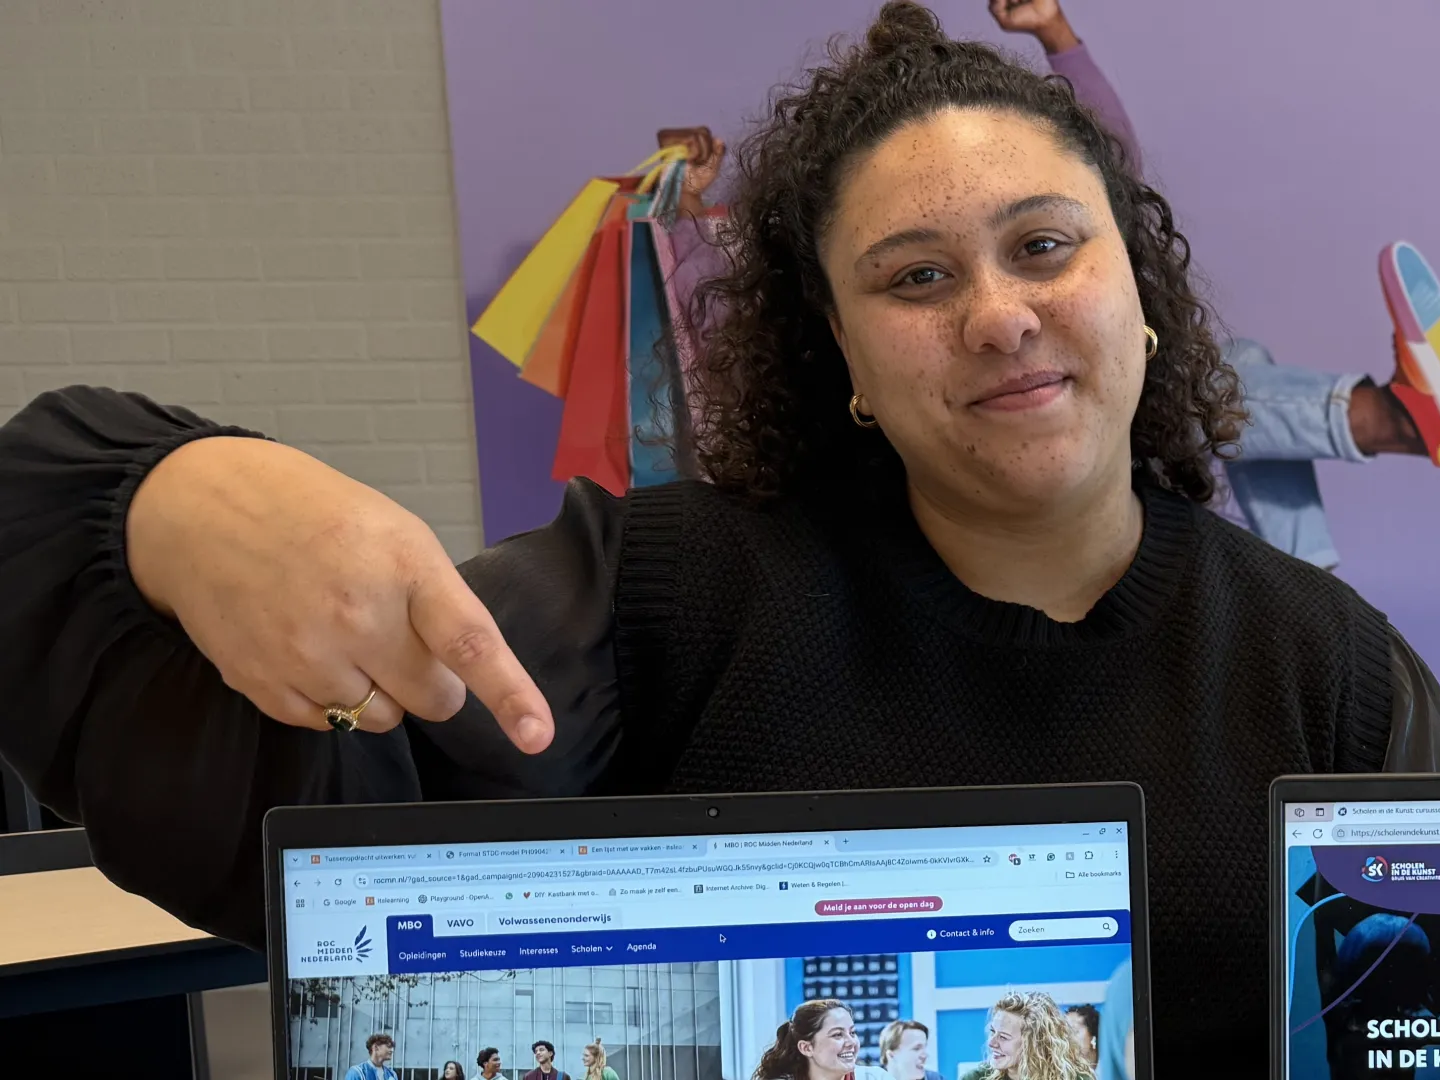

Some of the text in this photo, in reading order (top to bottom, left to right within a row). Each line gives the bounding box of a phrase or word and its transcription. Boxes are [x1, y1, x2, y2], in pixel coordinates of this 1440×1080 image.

[1352, 807, 1377, 815] Scholen
[1391, 862, 1425, 870] SCHOLEN
[791, 881, 811, 889] Weten
[817, 881, 841, 889] Regelen
[431, 894, 465, 902] Playground
[335, 899, 357, 907] Google
[823, 904, 843, 912] Meld
[844, 903, 852, 913] je
[887, 901, 898, 909] de
[899, 902, 918, 910] open
[920, 900, 935, 909] dag
[447, 918, 474, 928] VAVO
[498, 913, 612, 926] Volwassenenonderwijs
[397, 920, 423, 930] MBO
[1018, 925, 1045, 934] Zoeken
[939, 927, 995, 938] Contact & info
[317, 947, 353, 955] MIDDEN
[519, 946, 559, 955] Interesses
[571, 944, 603, 953] Scholen
[627, 942, 657, 952] Agenda
[398, 950, 447, 961] Opleidingen
[459, 948, 507, 958] Studiekeuze
[301, 954, 353, 963] NEDERLAND
[1368, 1050, 1393, 1069] IN
[1399, 1049, 1428, 1068] DE
